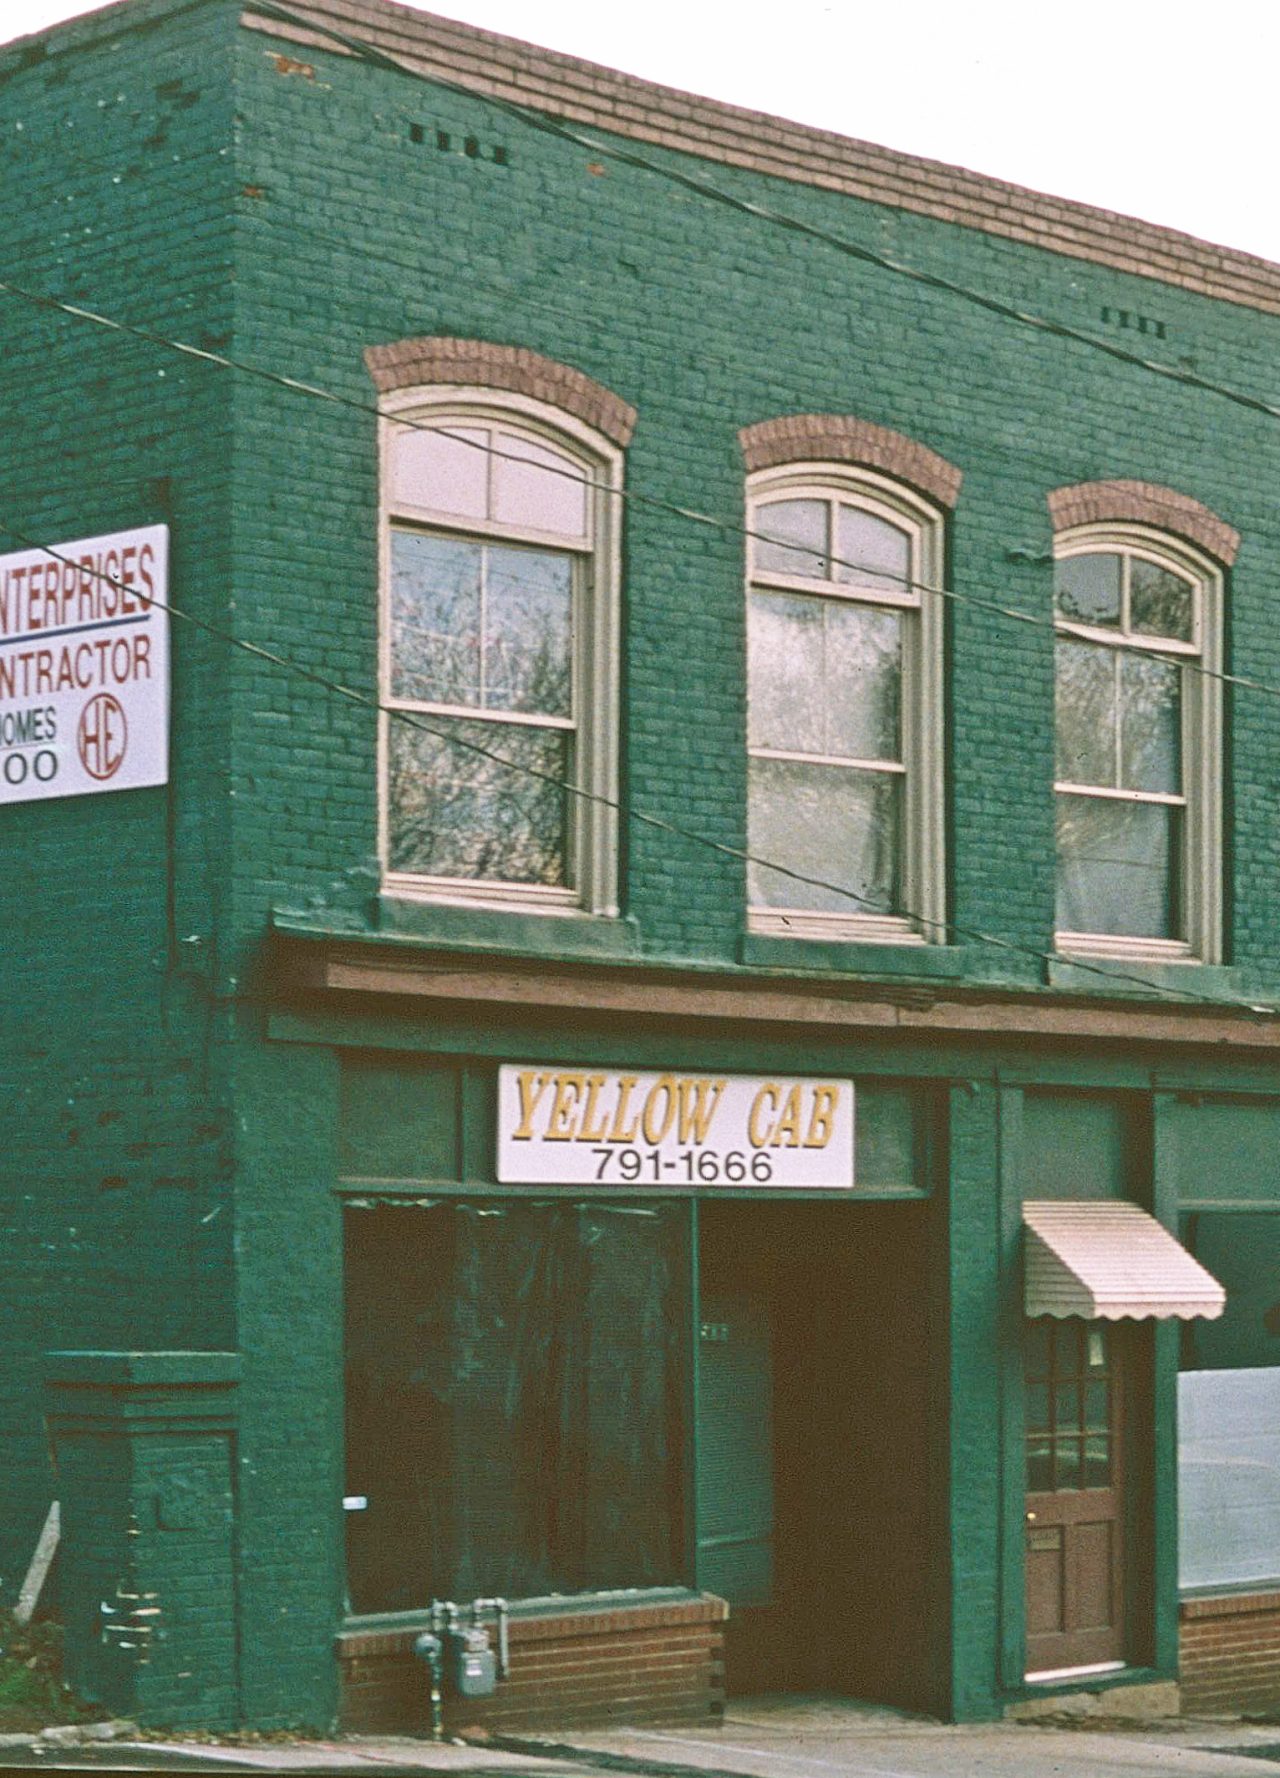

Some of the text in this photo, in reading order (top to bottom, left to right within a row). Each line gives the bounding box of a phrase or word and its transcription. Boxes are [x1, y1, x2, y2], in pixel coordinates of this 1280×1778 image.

[0, 634, 151, 699] NTRACTOR
[511, 1071, 842, 1150] YELLOW CAB
[590, 1148, 773, 1183] 791-1666
